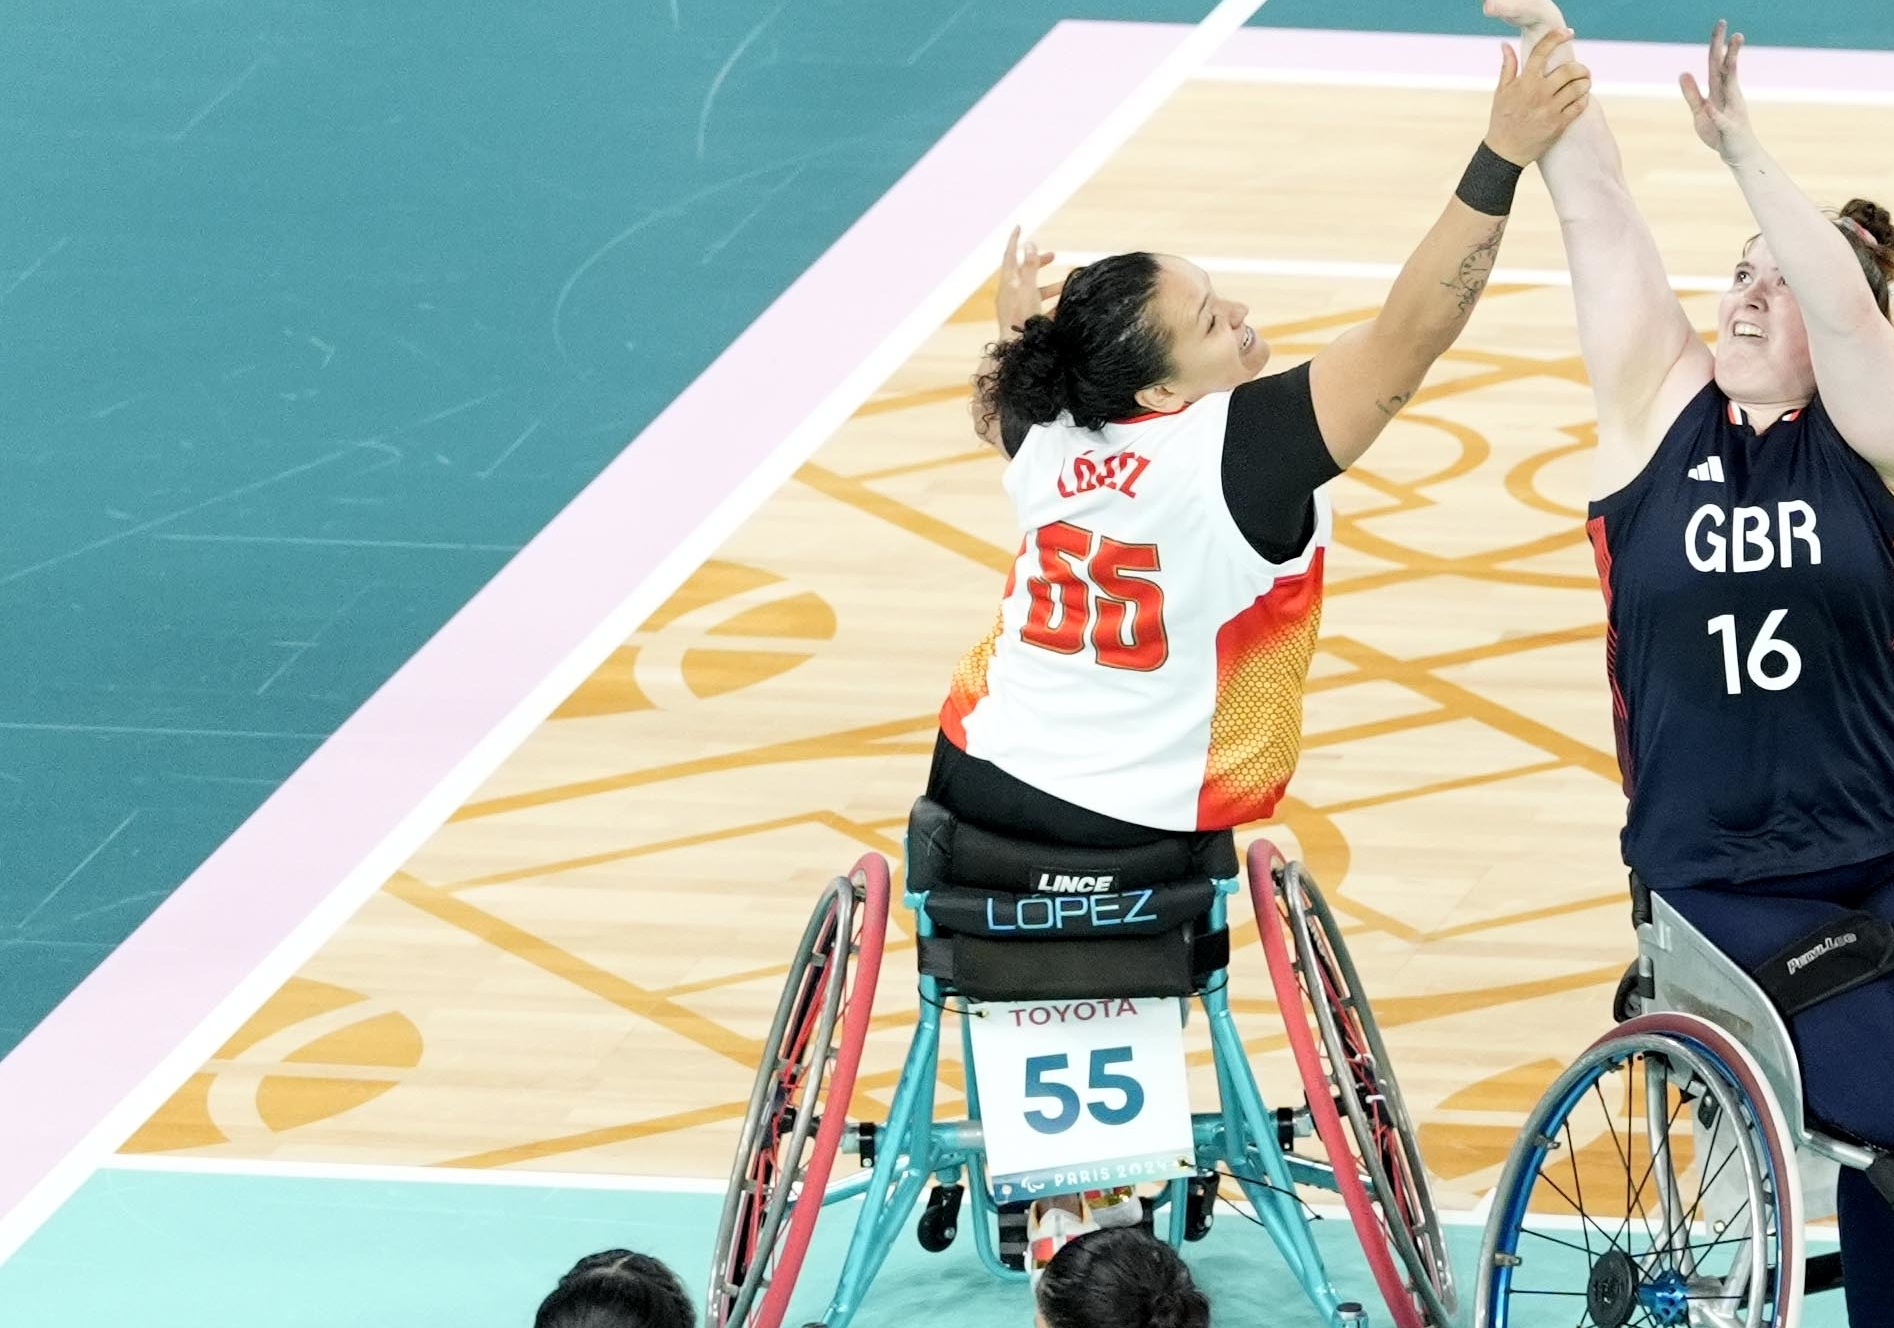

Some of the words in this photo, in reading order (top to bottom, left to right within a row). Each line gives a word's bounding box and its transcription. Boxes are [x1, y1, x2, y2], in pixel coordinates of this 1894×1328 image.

[1684, 498, 1822, 574] GBR
[1019, 519, 1170, 673] 55
[1707, 608, 1802, 696] 16
[1037, 873, 1114, 893] LINCE
[1008, 997, 1138, 1027] TOYOTA
[1023, 1045, 1145, 1135] 55
[1053, 1168, 1111, 1188] PARIS
[1117, 1159, 1169, 1181] 2024
